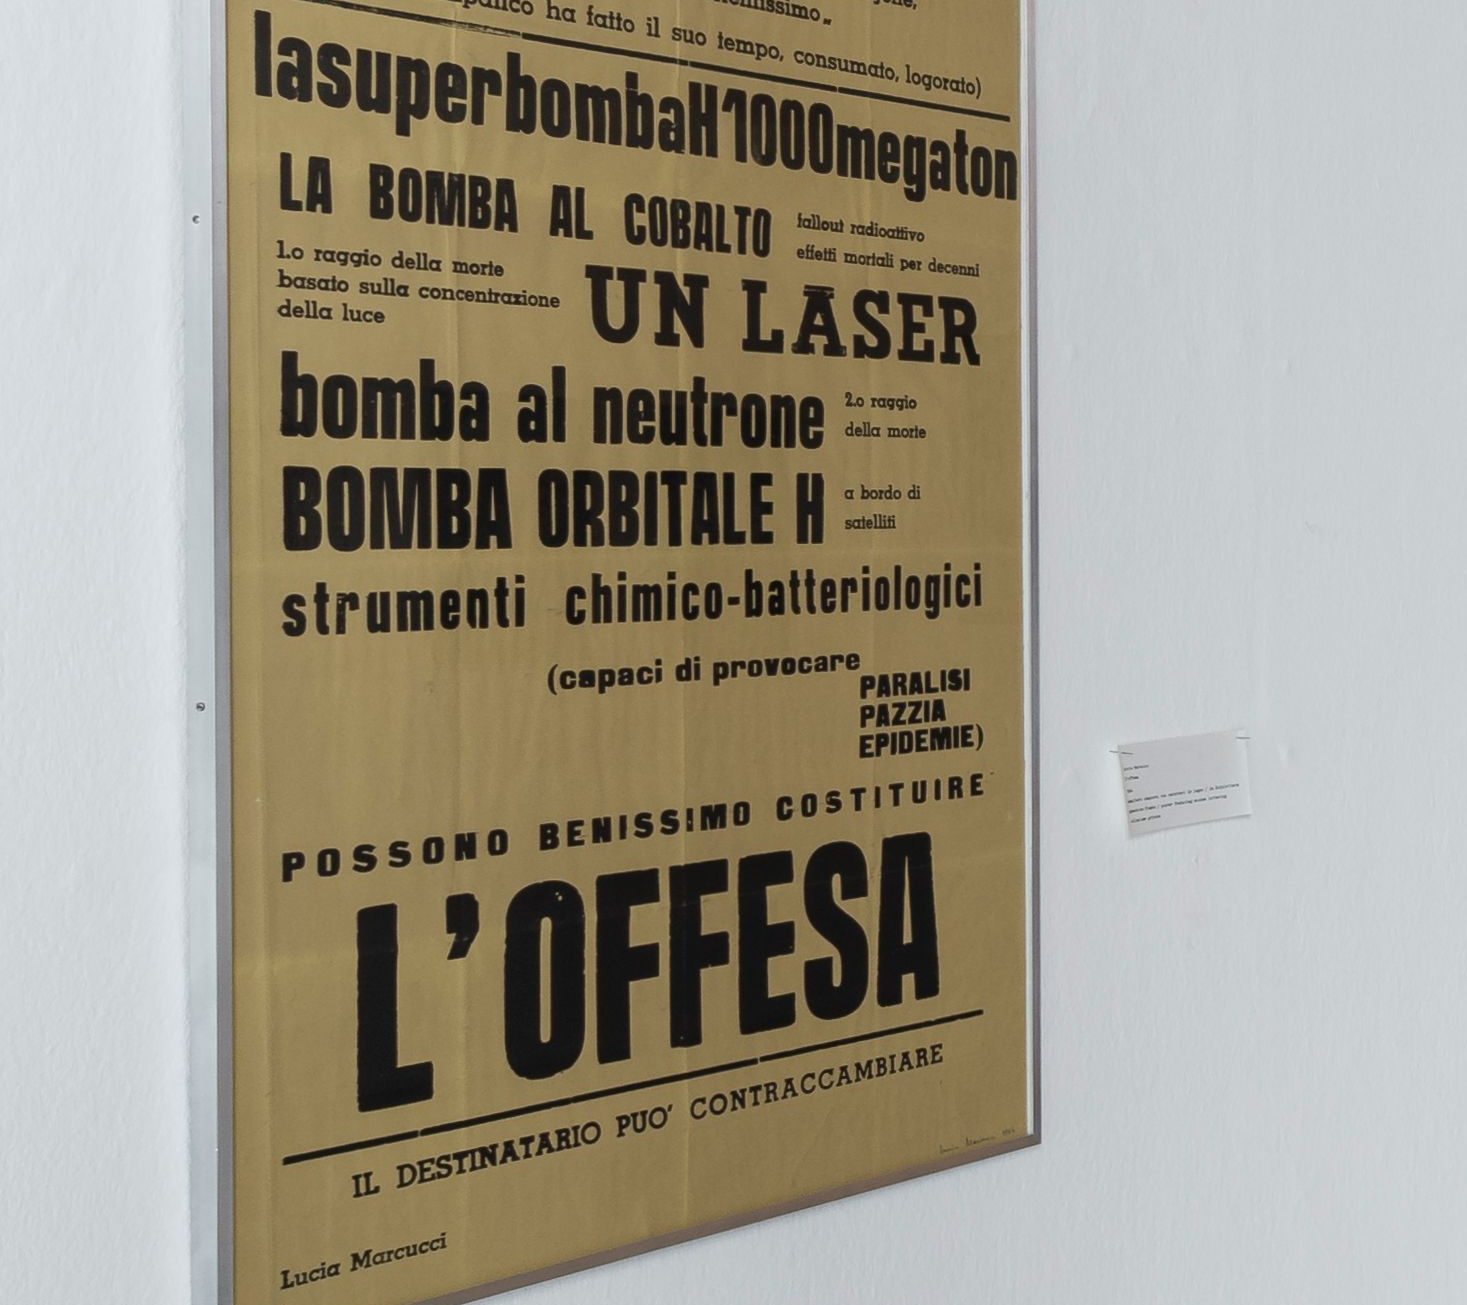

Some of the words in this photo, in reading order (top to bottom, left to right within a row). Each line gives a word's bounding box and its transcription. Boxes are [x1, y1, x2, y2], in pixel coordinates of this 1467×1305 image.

[586, 4, 635, 33] fatto
[646, 16, 661, 38] il
[671, 27, 707, 46] suo
[717, 31, 784, 62] tempo,
[793, 50, 899, 83] consumato,
[905, 64, 981, 100] logorato)
[279, 152, 332, 214] LA
[369, 163, 519, 233] BOMBA
[549, 184, 594, 240] AL
[624, 193, 772, 258] COBALTO
[797, 212, 844, 233] fallout
[850, 221, 925, 242] radioattivo
[313, 248, 382, 268] raggio
[391, 250, 442, 272] della
[452, 260, 504, 277] morte
[796, 244, 837, 262] effetti
[843, 252, 894, 268] mortali
[899, 258, 922, 271] per
[928, 257, 980, 278] decenni
[275, 268, 349, 293] basato
[359, 277, 410, 297] sulla
[418, 286, 560, 308] concentrazione
[276, 298, 333, 320] della
[341, 302, 385, 324] luce
[584, 264, 710, 349] UN
[741, 278, 980, 366] LASER
[279, 350, 490, 442] bomba
[516, 365, 566, 443] al
[592, 376, 825, 449] neutrone
[870, 395, 917, 411] raggio
[844, 421, 881, 438] della
[887, 425, 926, 439] morte
[282, 465, 513, 552] BOMBA
[537, 468, 774, 548] ORBITALE
[796, 472, 824, 544] H
[844, 489, 855, 500] a
[860, 484, 902, 500] bordo
[907, 484, 921, 500] di
[844, 514, 896, 530] satelliti
[281, 574, 525, 637] strumenti
[565, 563, 982, 625] chimico-batteriologici
[547, 658, 663, 695] (capaci
[675, 656, 701, 682] di
[712, 653, 860, 686] provocare
[860, 668, 970, 699] PARALISI
[860, 698, 946, 728] PAZZIA
[859, 723, 984, 759] EPIDEMIE)
[281, 829, 508, 883] POSSONO
[539, 801, 750, 851] BENISSIMO
[776, 773, 984, 821] COSTITUIRE
[356, 831, 940, 1113] L'OFFESA
[352, 1171, 381, 1198] IL
[396, 1121, 601, 1189] DESTINATARIO
[690, 1043, 943, 1120] CONTRACCAMBIARE
[280, 1262, 341, 1290] Lucia
[350, 1233, 447, 1272] Marcucci
